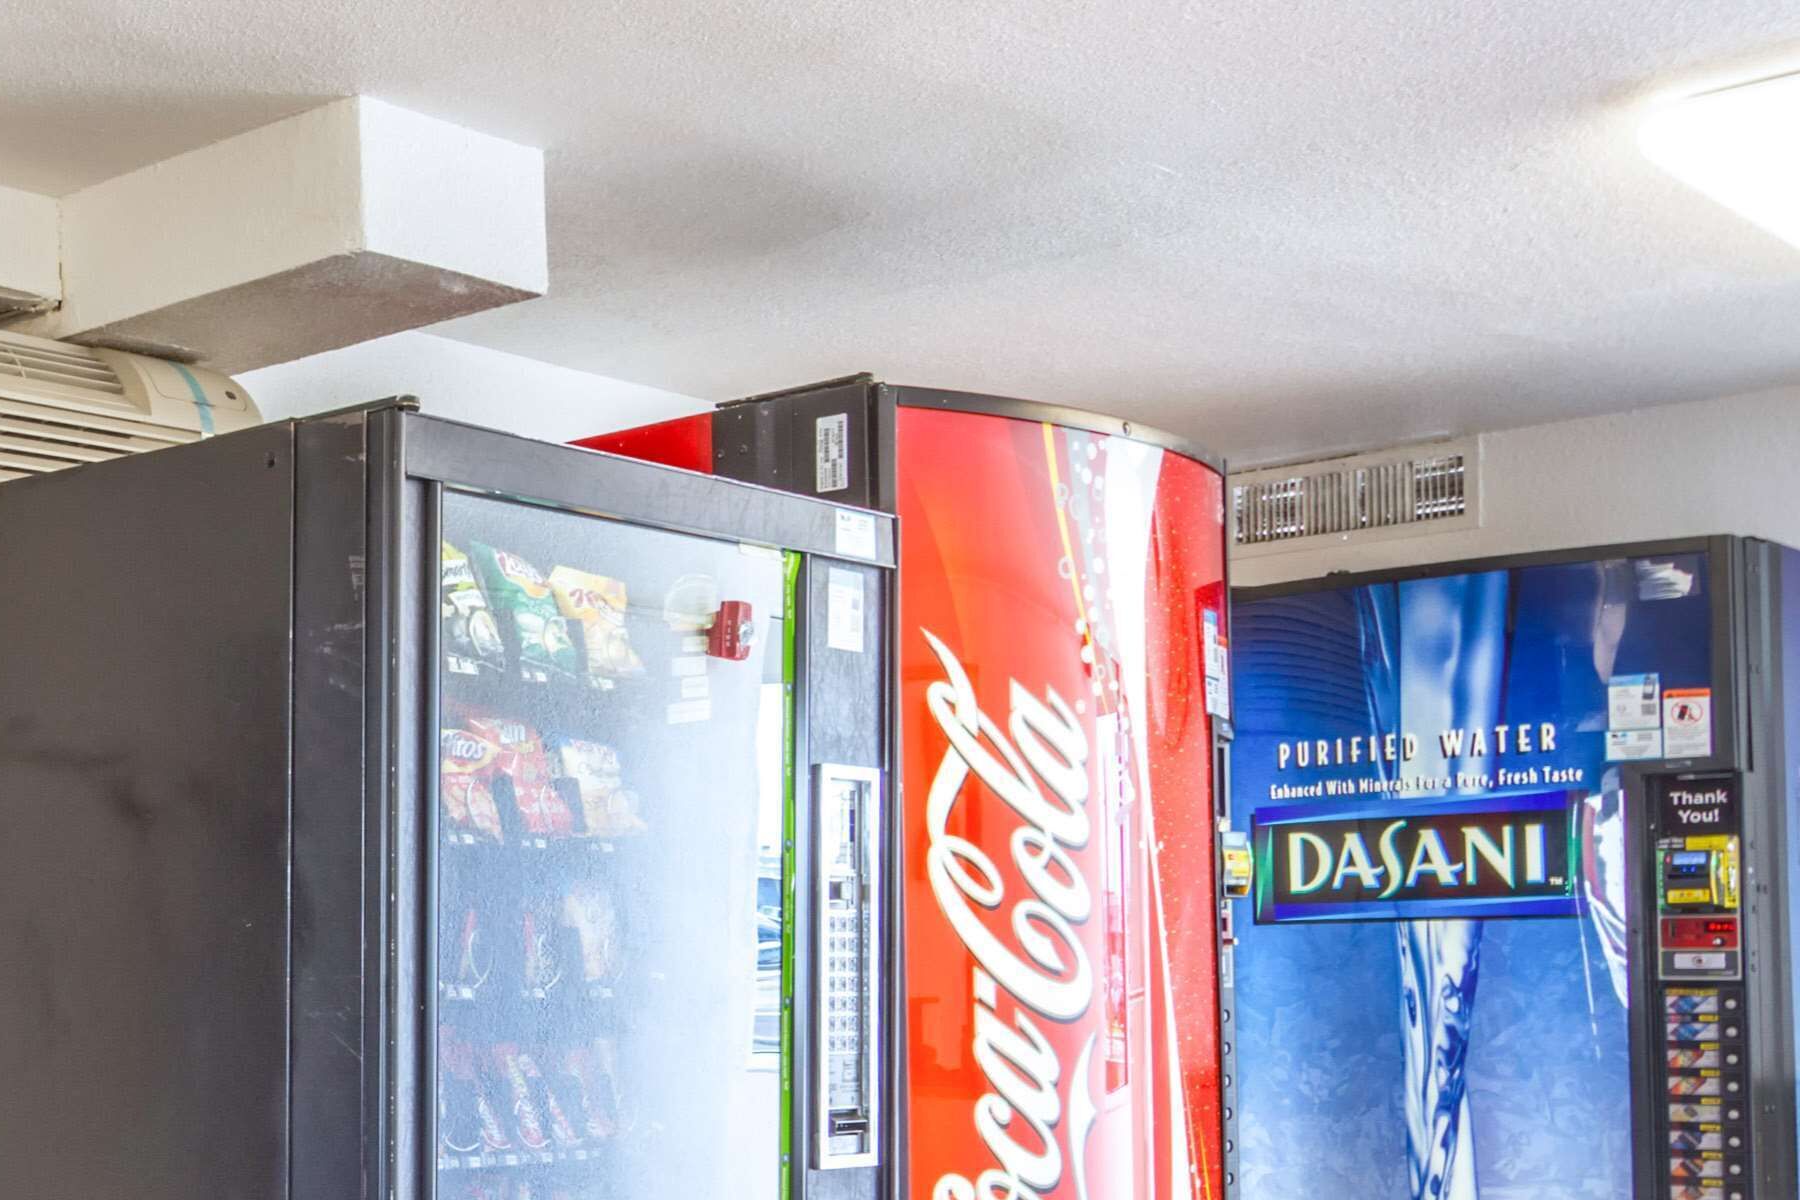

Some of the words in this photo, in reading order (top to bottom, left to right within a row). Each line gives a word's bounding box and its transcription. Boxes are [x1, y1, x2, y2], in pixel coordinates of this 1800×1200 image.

[1278, 731, 1418, 771] PURIFIED
[1439, 722, 1557, 759] WATER
[1270, 782, 1322, 799] Enhanced
[1326, 779, 1355, 795] With
[1359, 777, 1410, 793] Minerals
[1499, 767, 1538, 785] Fresh
[1542, 765, 1584, 784] Taste
[1669, 789, 1729, 806] Thank
[1677, 808, 1720, 824] You!
[1288, 820, 1544, 899] DASANI
